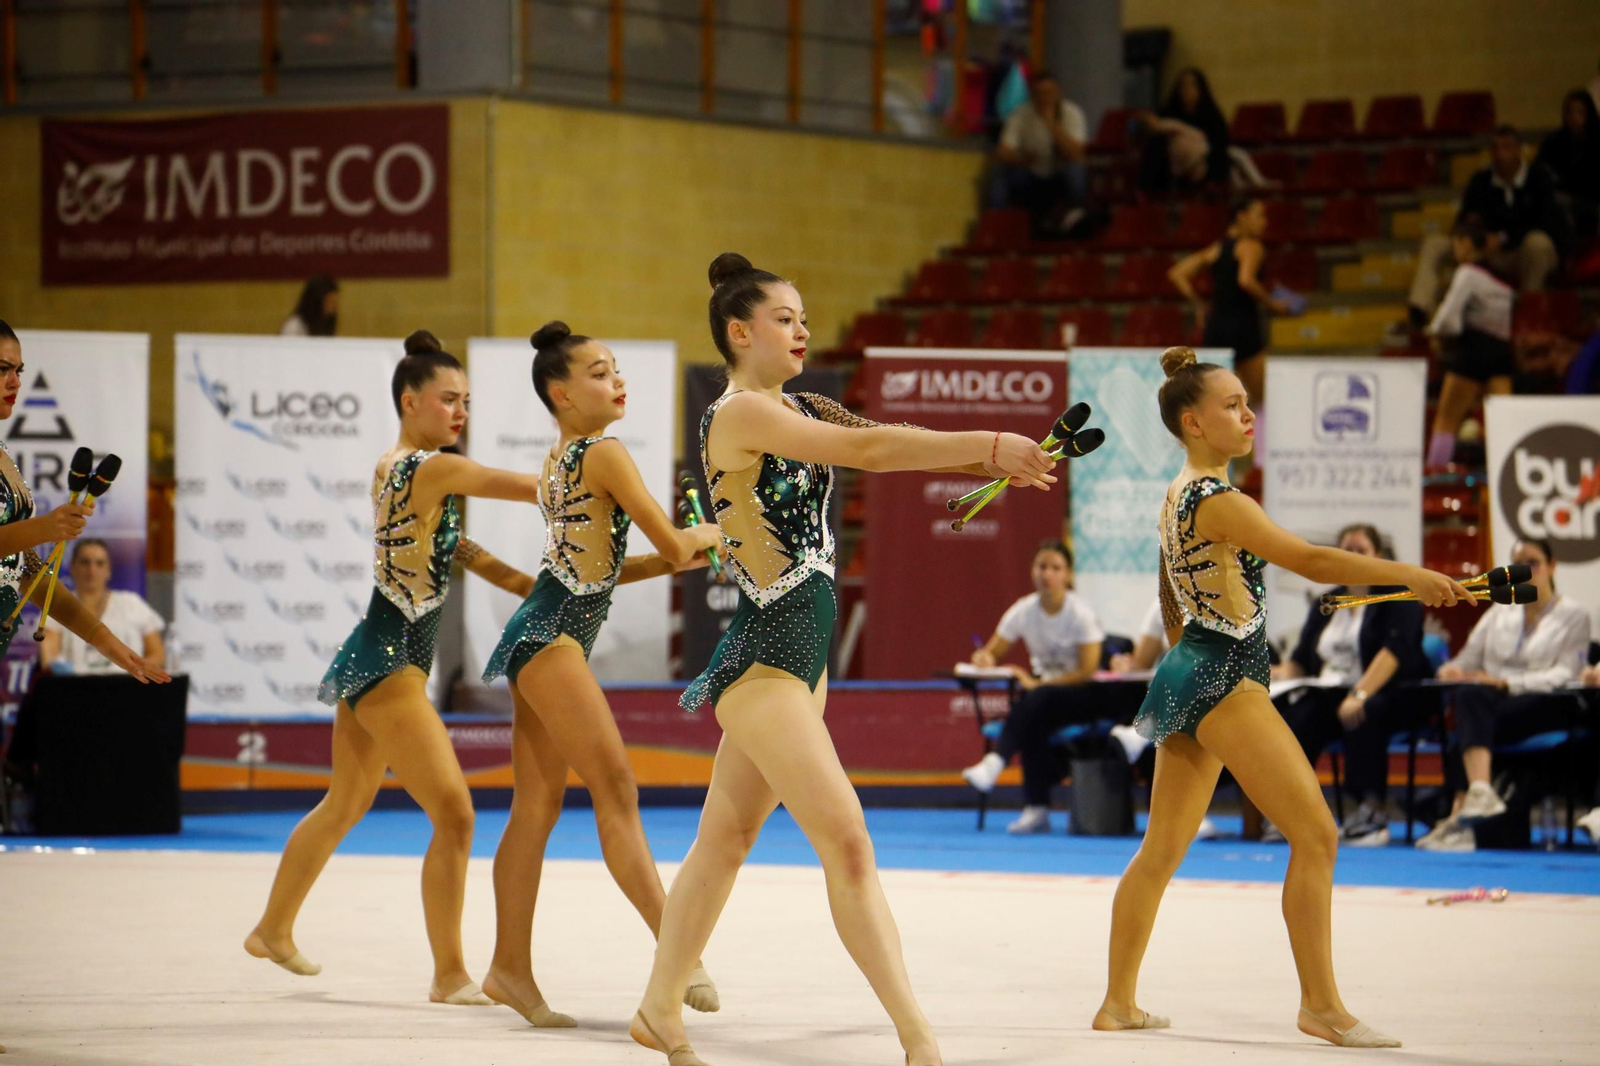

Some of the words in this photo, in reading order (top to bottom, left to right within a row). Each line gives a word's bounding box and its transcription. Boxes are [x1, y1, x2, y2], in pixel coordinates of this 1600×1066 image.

[143, 142, 436, 222] IMDECO
[920, 368, 1053, 402] IMDECO
[236, 731, 267, 764] 2
